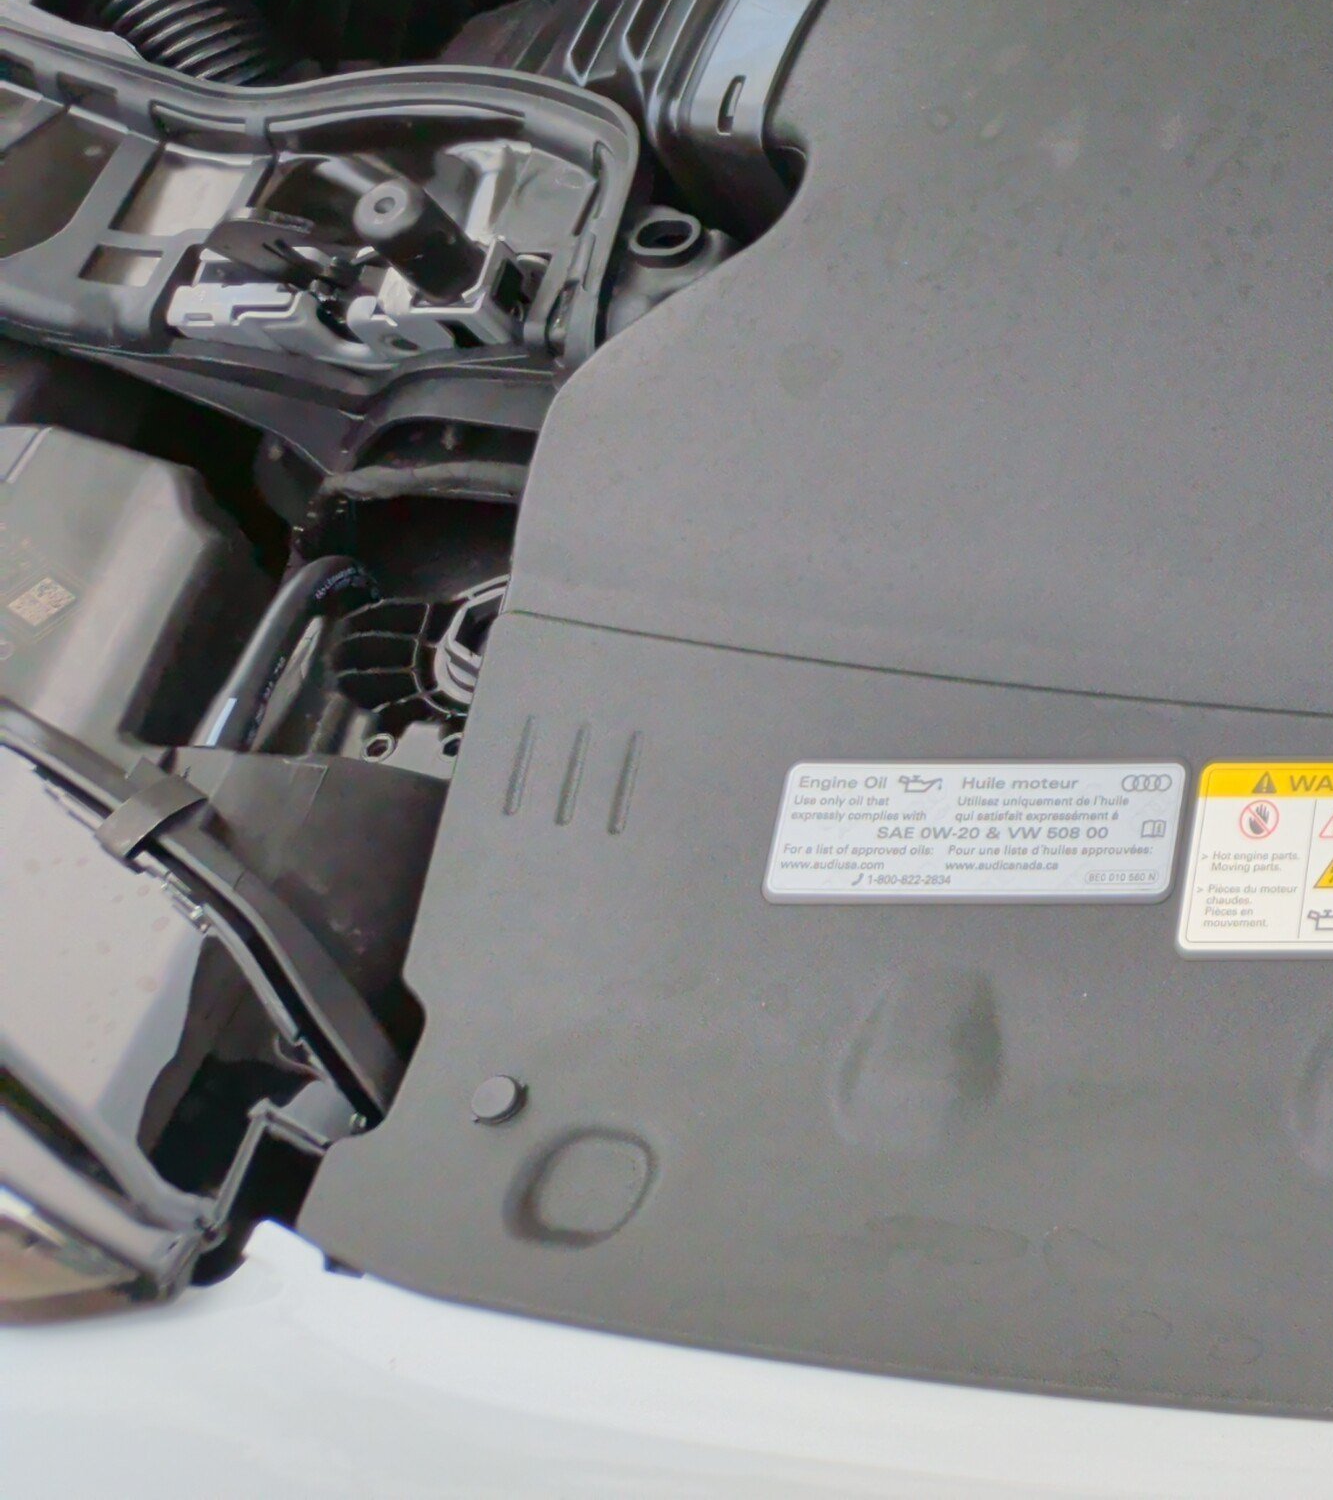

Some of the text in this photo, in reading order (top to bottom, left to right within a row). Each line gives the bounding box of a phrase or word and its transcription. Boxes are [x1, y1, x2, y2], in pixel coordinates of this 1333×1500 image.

[799, 776, 888, 791] Engine Oil
[962, 777, 1078, 790] Huile moteur
[794, 795, 890, 808] Use only oil that
[957, 796, 1129, 808] Utilisez uniquement de l'huile
[791, 811, 926, 822] expressly complies with
[955, 810, 974, 822] qui
[977, 810, 1022, 821] satisfait
[1026, 810, 1108, 822] expressément
[878, 827, 1109, 839] SAE 0W-20 & VW 508 00
[784, 844, 802, 855] For
[816, 844, 832, 855] list
[836, 844, 848, 855] of
[851, 844, 906, 857] approved
[910, 844, 934, 855] oils:
[948, 845, 1152, 857] Pour une liste d'huiles approuvées:
[1213, 851, 1231, 860] Hot
[1234, 852, 1268, 862] engine
[780, 860, 884, 870] www.audiusa.com
[945, 861, 1059, 870] www.audicanada.ca
[1211, 862, 1281, 872] Moving parts.
[868, 875, 951, 885] 1-800-822-2834
[1244, 883, 1257, 893] du
[1260, 883, 1297, 893] moteur
[1206, 896, 1252, 904] chaudes.
